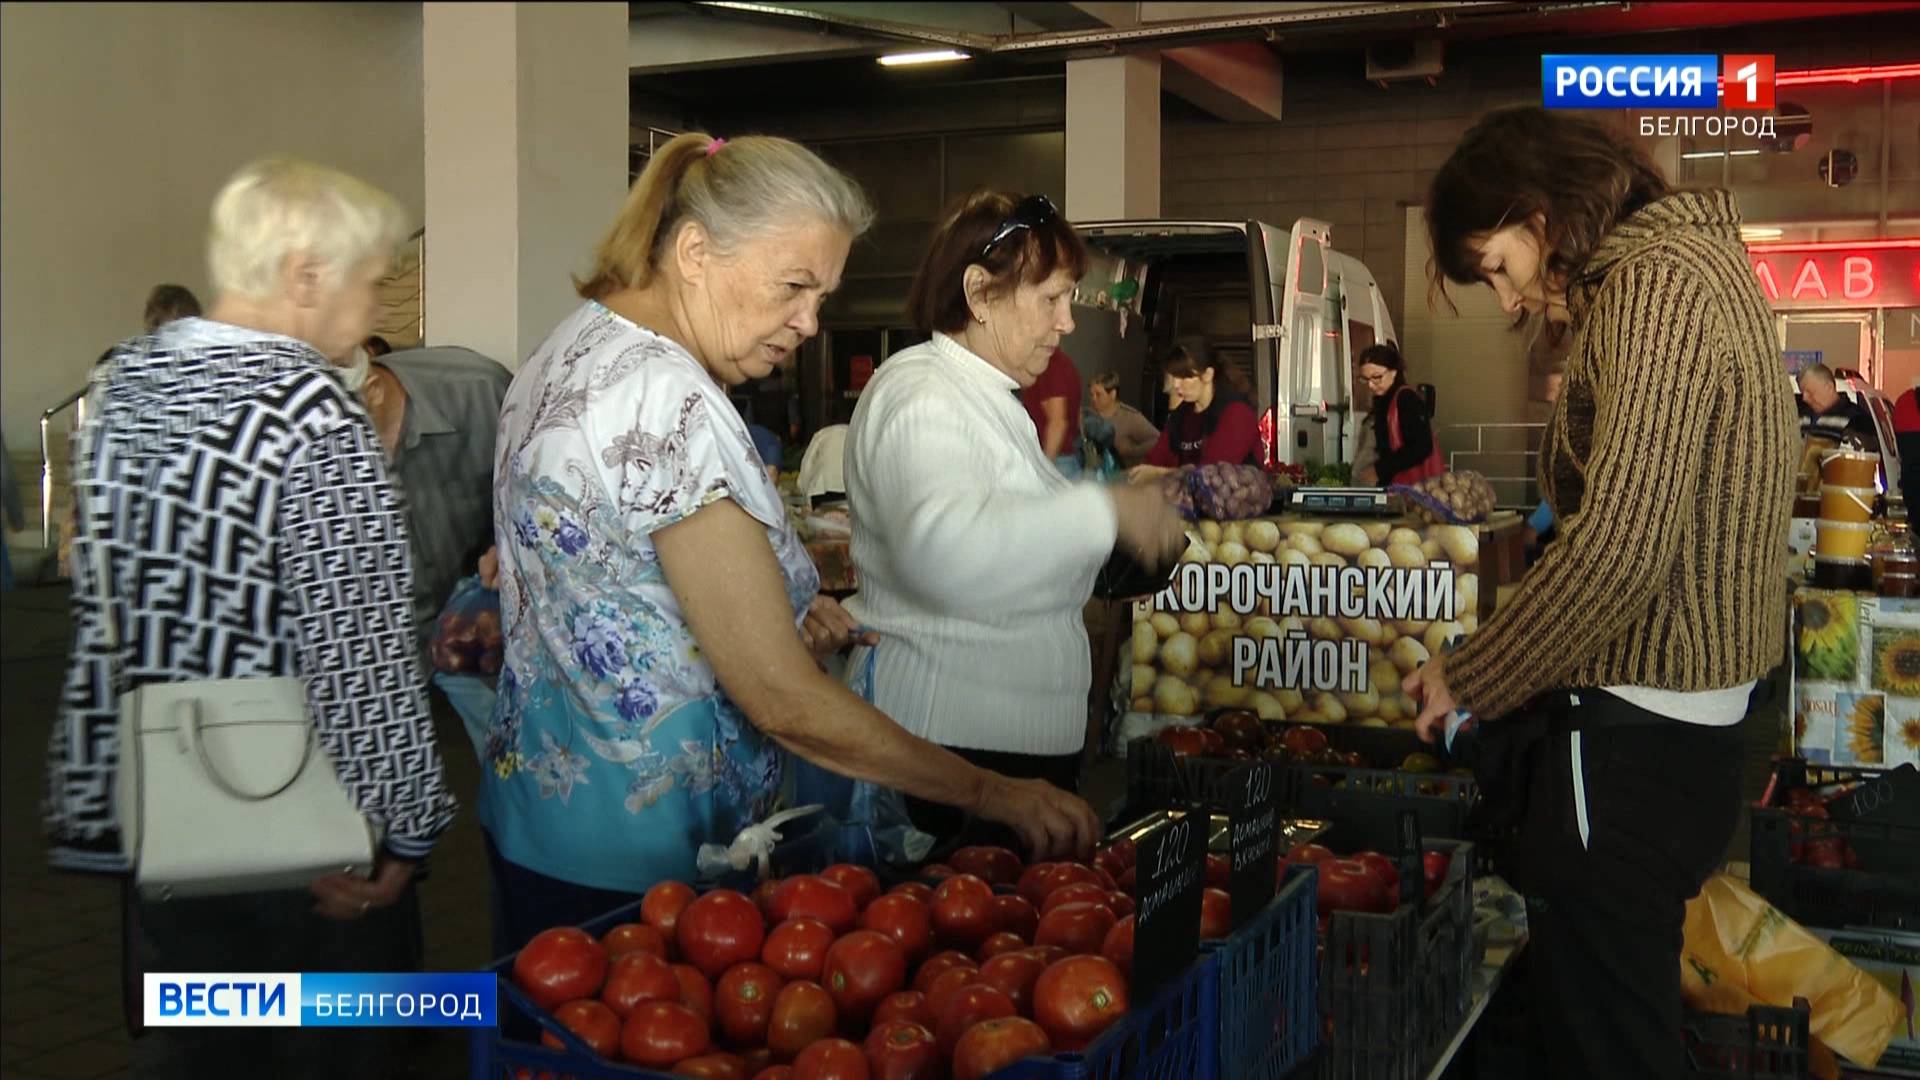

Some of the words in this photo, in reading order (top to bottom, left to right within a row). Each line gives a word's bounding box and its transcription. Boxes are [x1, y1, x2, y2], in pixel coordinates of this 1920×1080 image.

[1154, 560, 1456, 622] КОРОЧАНСКИЙ
[1232, 629, 1369, 694] РАЙОН
[1244, 763, 1272, 809] 120
[1151, 819, 1190, 879] 120
